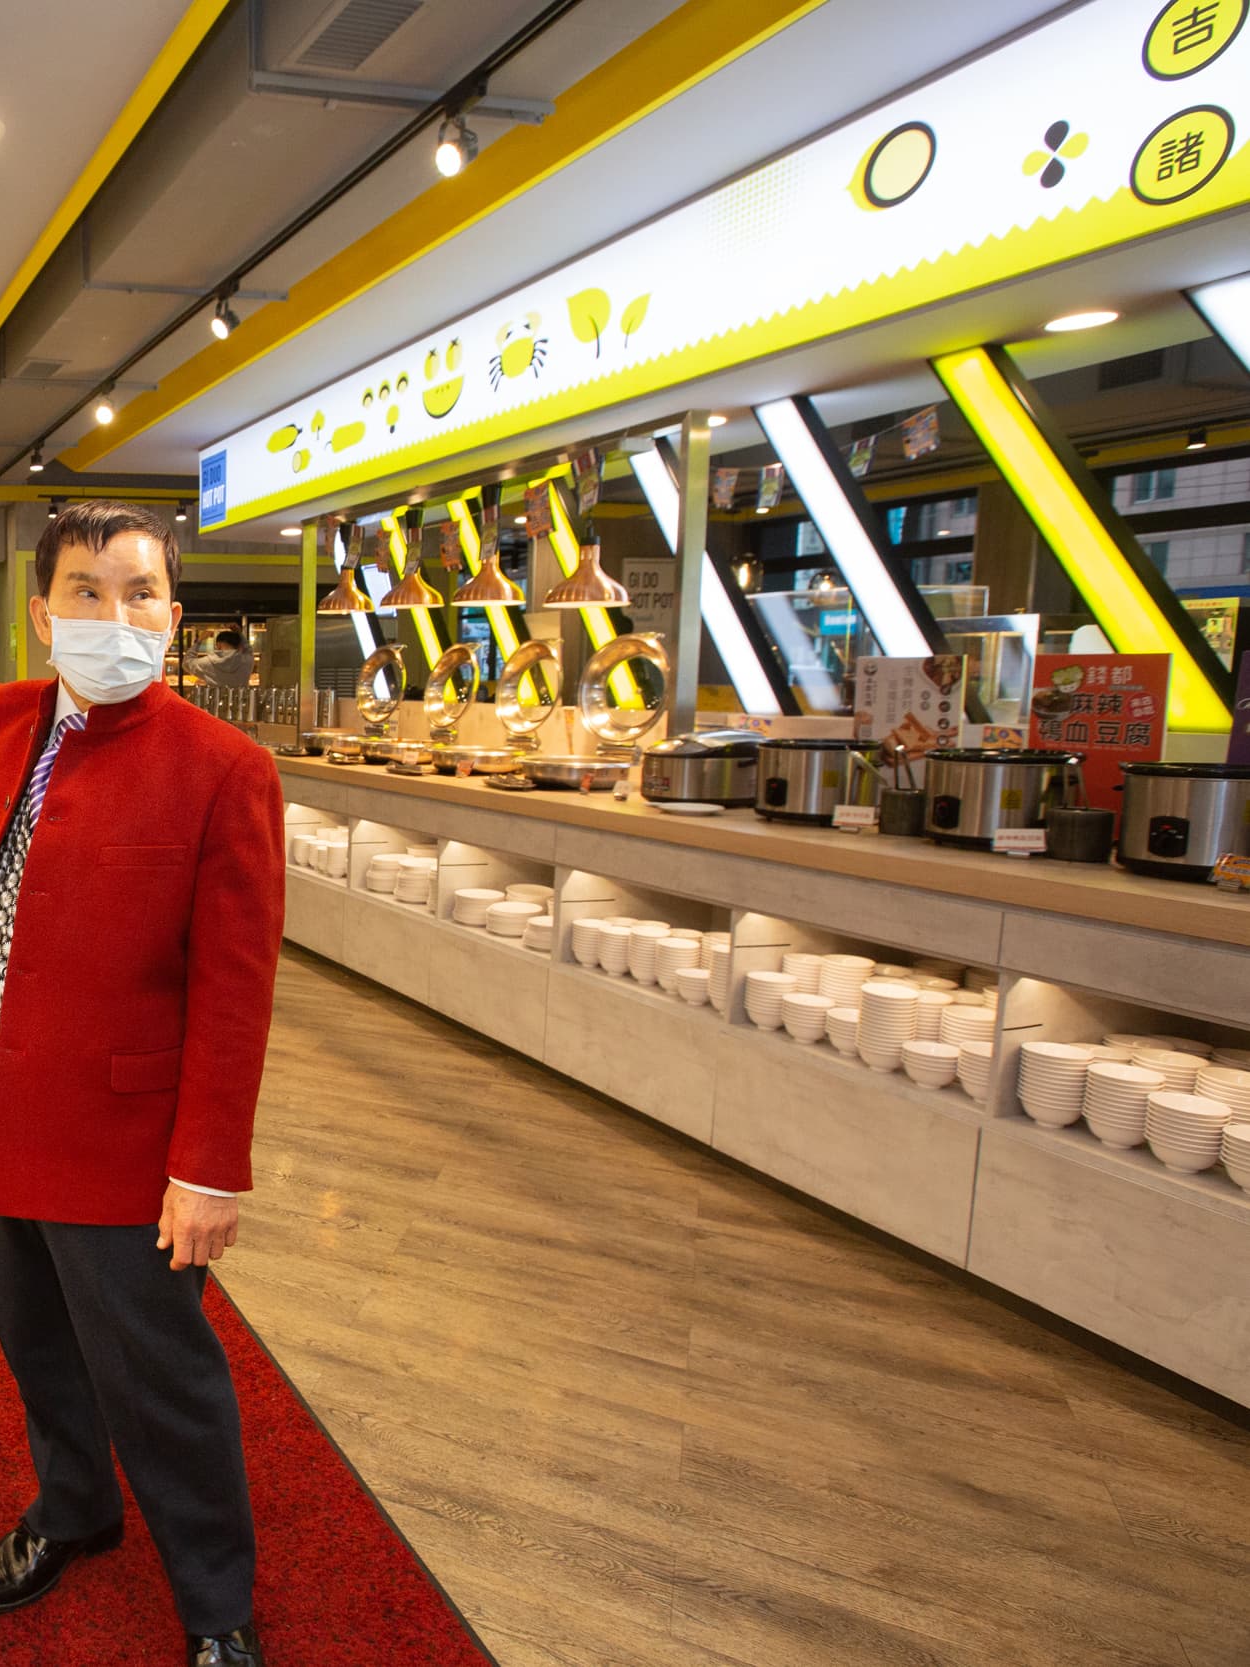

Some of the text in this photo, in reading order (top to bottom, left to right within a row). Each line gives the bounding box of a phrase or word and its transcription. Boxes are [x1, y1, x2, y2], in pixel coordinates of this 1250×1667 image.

[1171, 1, 1221, 55] 吉
[1156, 130, 1205, 183] 諸
[202, 483, 225, 510] HOT POT
[652, 591, 674, 609] POT
[1072, 691, 1125, 716] 麻辣
